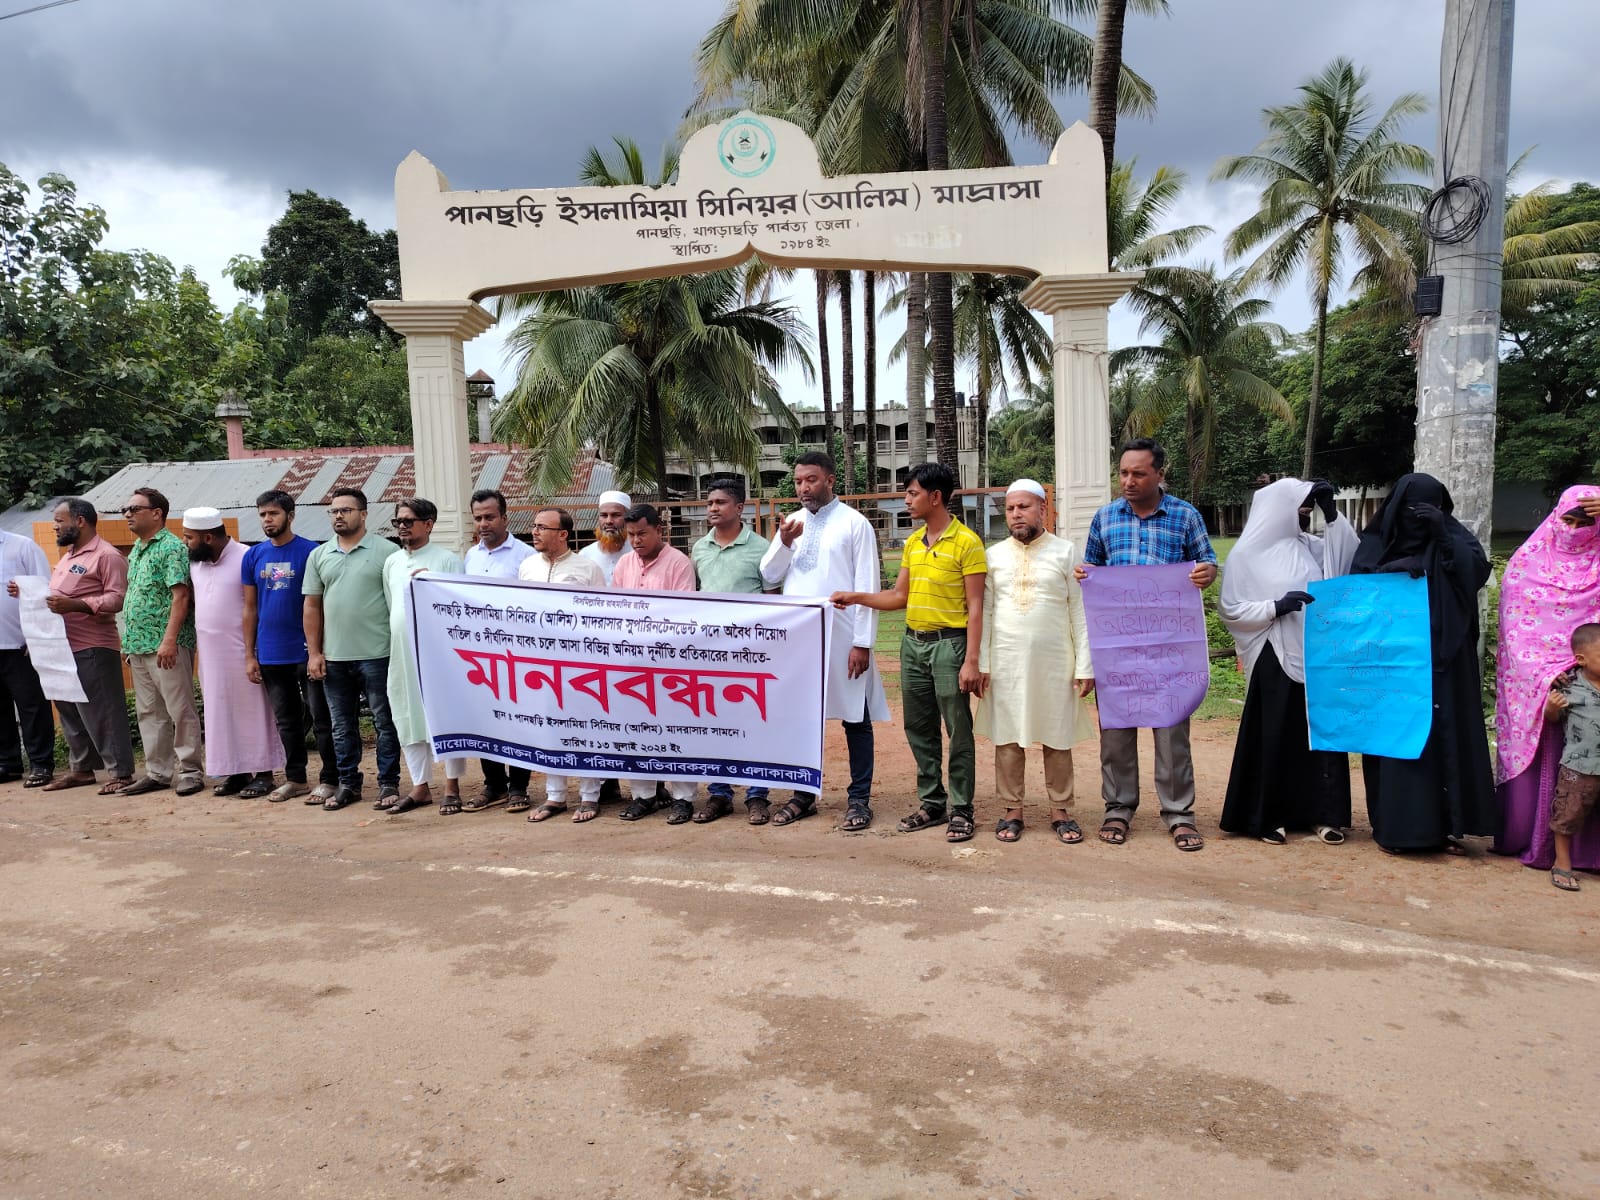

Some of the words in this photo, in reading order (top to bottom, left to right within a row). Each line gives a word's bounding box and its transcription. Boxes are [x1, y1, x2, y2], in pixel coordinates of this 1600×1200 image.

[445, 195, 547, 228] পানছড়ি
[556, 193, 688, 225] ইসলামিয়া
[696, 187, 799, 219] সিনিয়র
[693, 220, 759, 238] খাগড়াছড়ি
[766, 220, 808, 233] পার্বত্য
[432, 601, 462, 619] পানছড়ি
[464, 602, 503, 621] ইসলামিয়া
[506, 606, 537, 625] সিনিয়র
[581, 615, 623, 632] মাদরাসার
[700, 624, 721, 638] পদে
[723, 622, 752, 640] অবৈধ
[754, 623, 787, 641] নিয়োগ
[446, 625, 471, 642] বাতিল
[474, 631, 481, 642] ও
[538, 638, 556, 651] চলে
[558, 638, 580, 653] আসা
[583, 637, 610, 656] বিভিন্ন
[612, 639, 645, 657] অনিয়ম
[679, 644, 728, 662] প্রতিকারের
[453, 648, 778, 721] মানববন্ধন
[546, 716, 588, 730] ইসলামিয়া
[666, 725, 709, 736] মাদরাসার
[560, 737, 587, 748] তারিখ
[596, 740, 610, 749] ১৩
[640, 743, 667, 753] ২০২৪
[726, 765, 738, 774] ও
